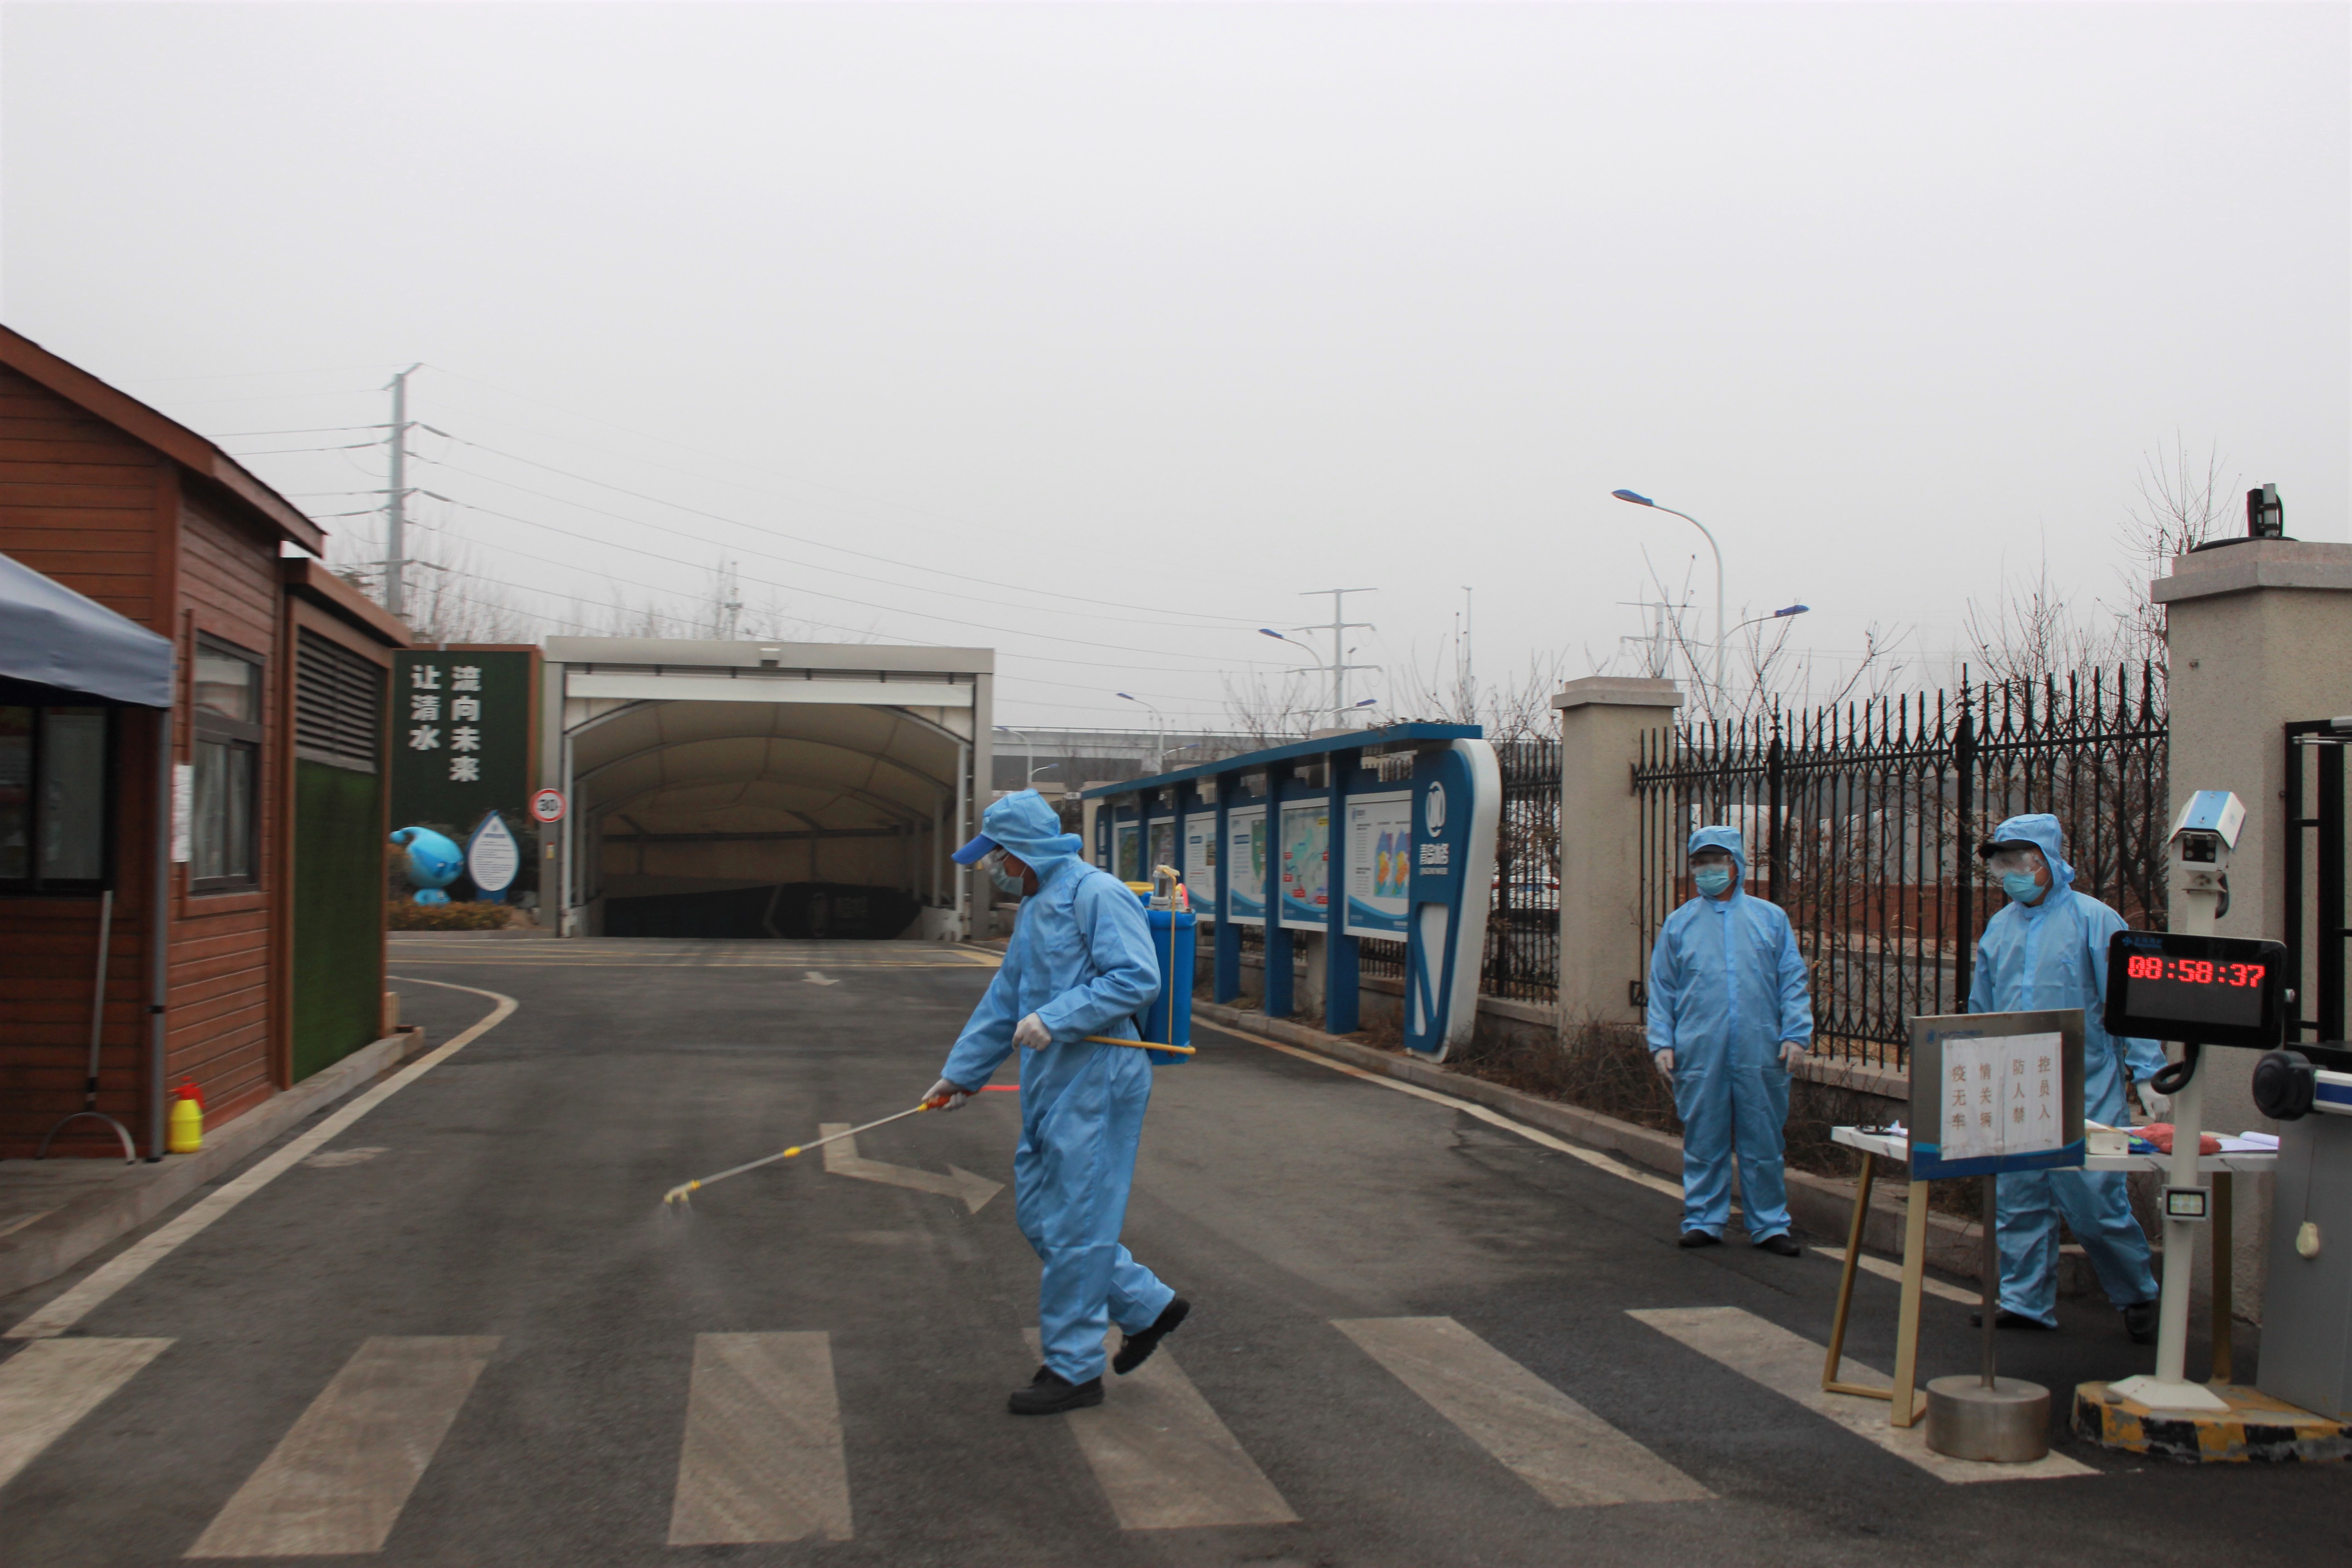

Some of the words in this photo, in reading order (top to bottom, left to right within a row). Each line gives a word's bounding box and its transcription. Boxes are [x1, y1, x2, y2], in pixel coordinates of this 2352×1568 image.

[409, 665, 441, 750] 让清水
[449, 665, 482, 782] 流向未来
[2127, 956, 2266, 988] 08:58:37
[1951, 1056, 2050, 1082] 疫情防控
[1951, 1079, 2050, 1107] 无关人员
[1951, 1103, 2050, 1130] 车辆禁入
